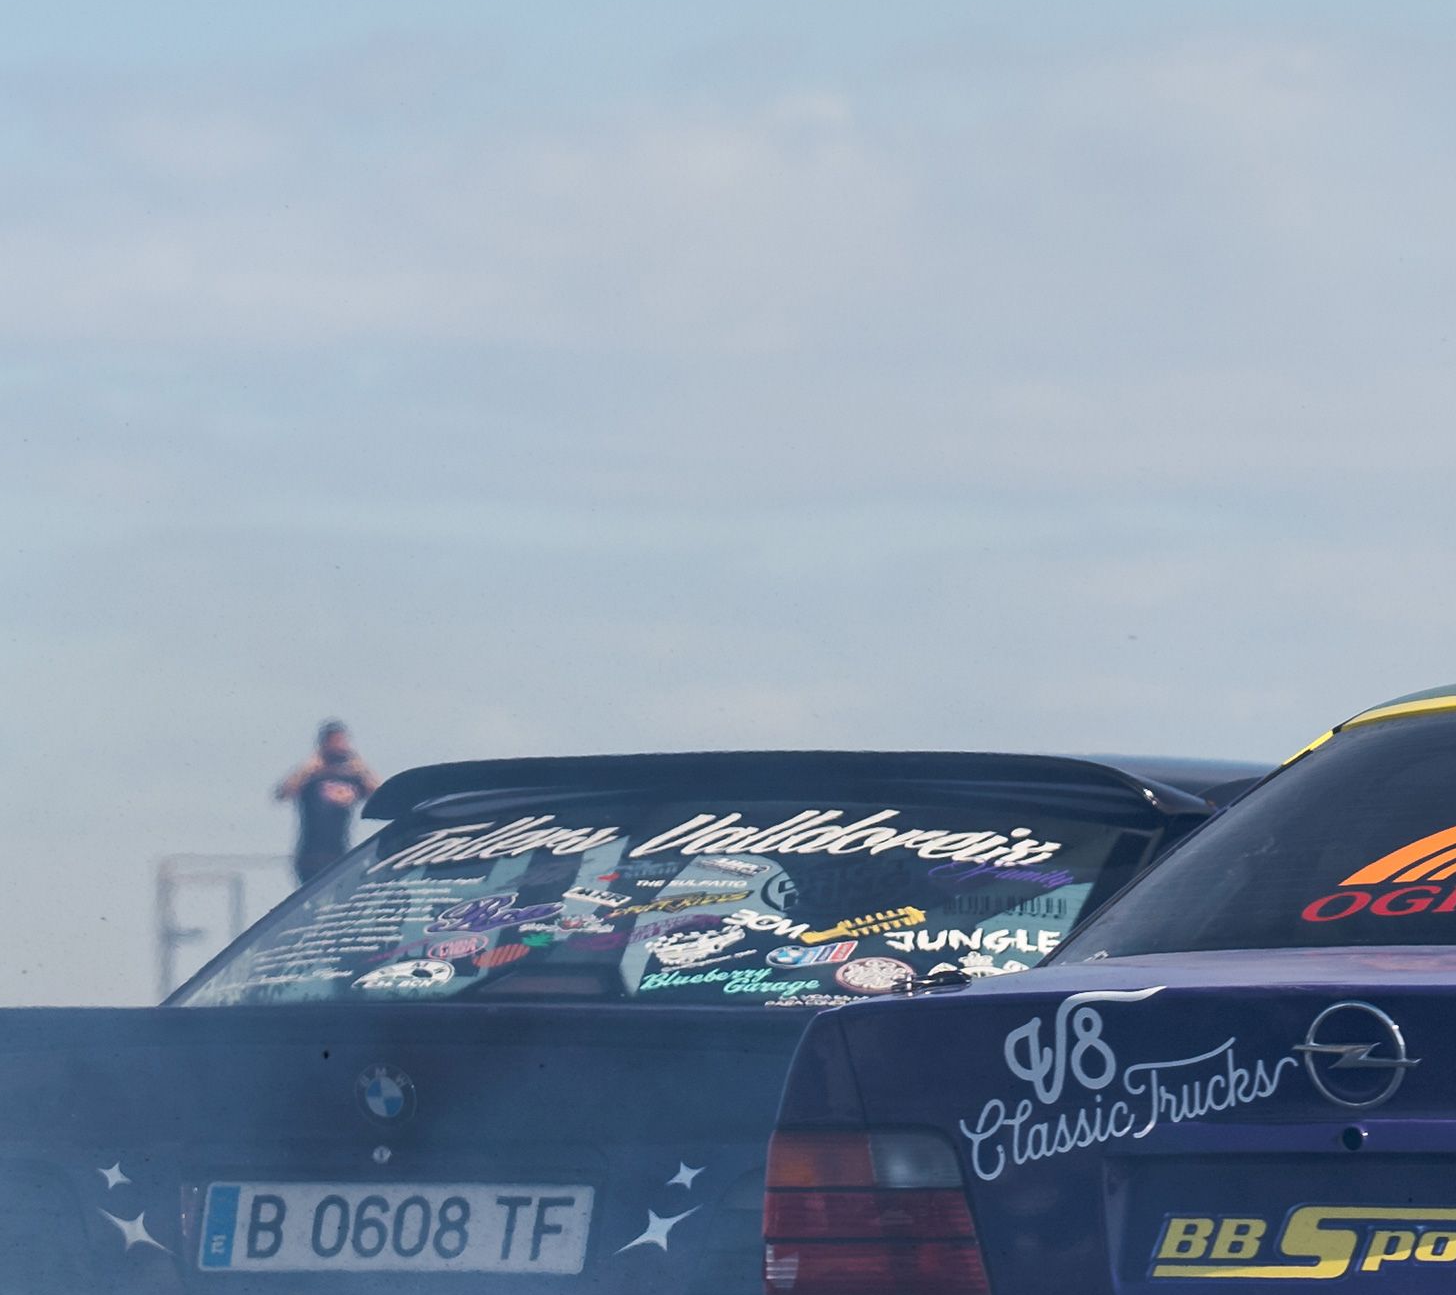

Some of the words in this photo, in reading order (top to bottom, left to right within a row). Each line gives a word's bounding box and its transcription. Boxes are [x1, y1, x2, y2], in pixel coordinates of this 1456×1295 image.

[636, 879, 665, 887] THE
[884, 929, 1062, 953] JUNGLE
[640, 968, 772, 990] Blueberry
[723, 977, 820, 996] Garage
[1004, 986, 1167, 1104] V8
[960, 1100, 1135, 1181] Classic
[1124, 1037, 1299, 1139] Trucks
[247, 1194, 286, 1259] B
[311, 1194, 470, 1259] 0608
[496, 1196, 575, 1261] TF
[1157, 1218, 1267, 1259] BB
